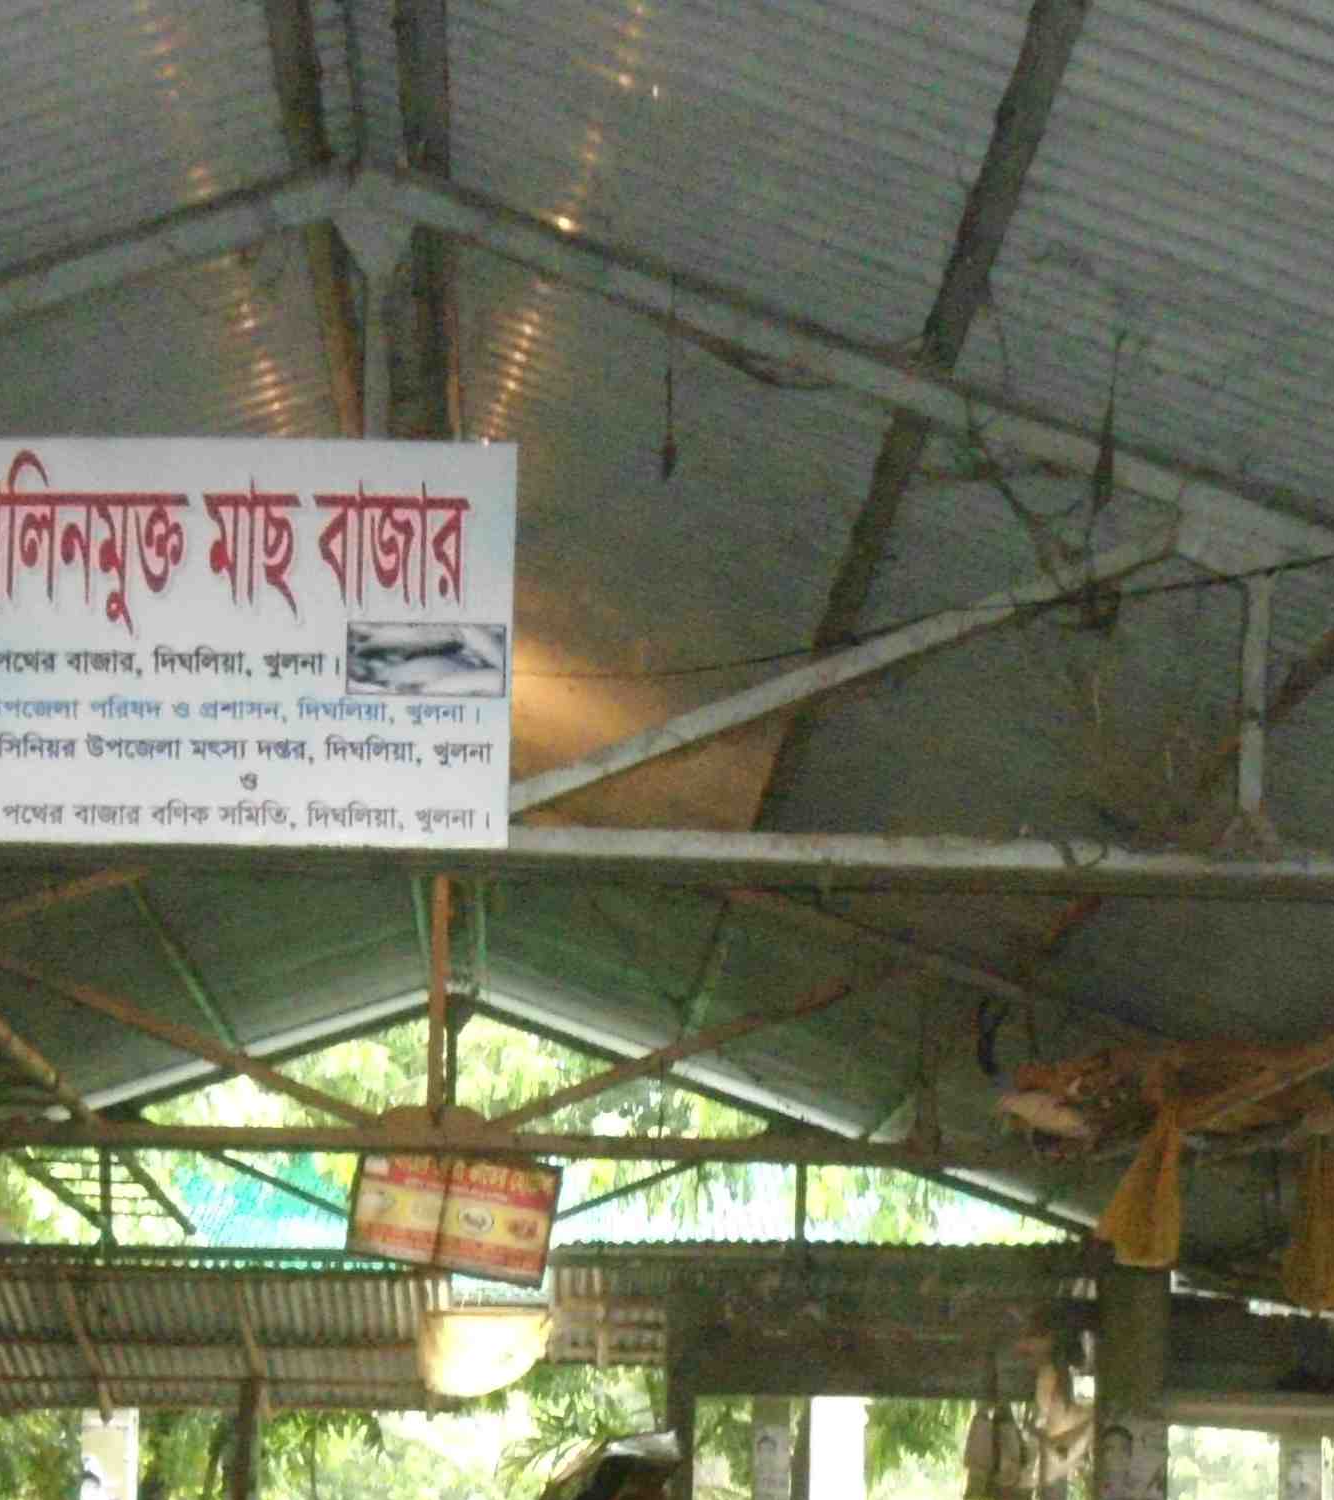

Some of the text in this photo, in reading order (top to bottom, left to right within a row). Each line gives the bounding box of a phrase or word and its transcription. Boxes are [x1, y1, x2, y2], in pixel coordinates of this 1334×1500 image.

[202, 474, 302, 618] মাছ
[313, 479, 471, 607] বাজার
[67, 648, 144, 678] বাজার,
[153, 645, 253, 677] দিঘলিয়া,
[90, 696, 163, 720] পরিষদ
[173, 699, 191, 720] ও
[199, 699, 289, 724] প্রশাসন,
[297, 696, 396, 725] দিঘলিয়া,
[85, 732, 182, 762] উপজেলা
[324, 734, 424, 766] দিঘলিয়া,
[433, 740, 494, 766] খুলনা
[239, 771, 259, 791] ও
[2, 803, 66, 826] পথের
[74, 802, 141, 827] বাজার
[218, 800, 298, 830] সমিতি,
[306, 800, 405, 832] দিঘলিয়া,
